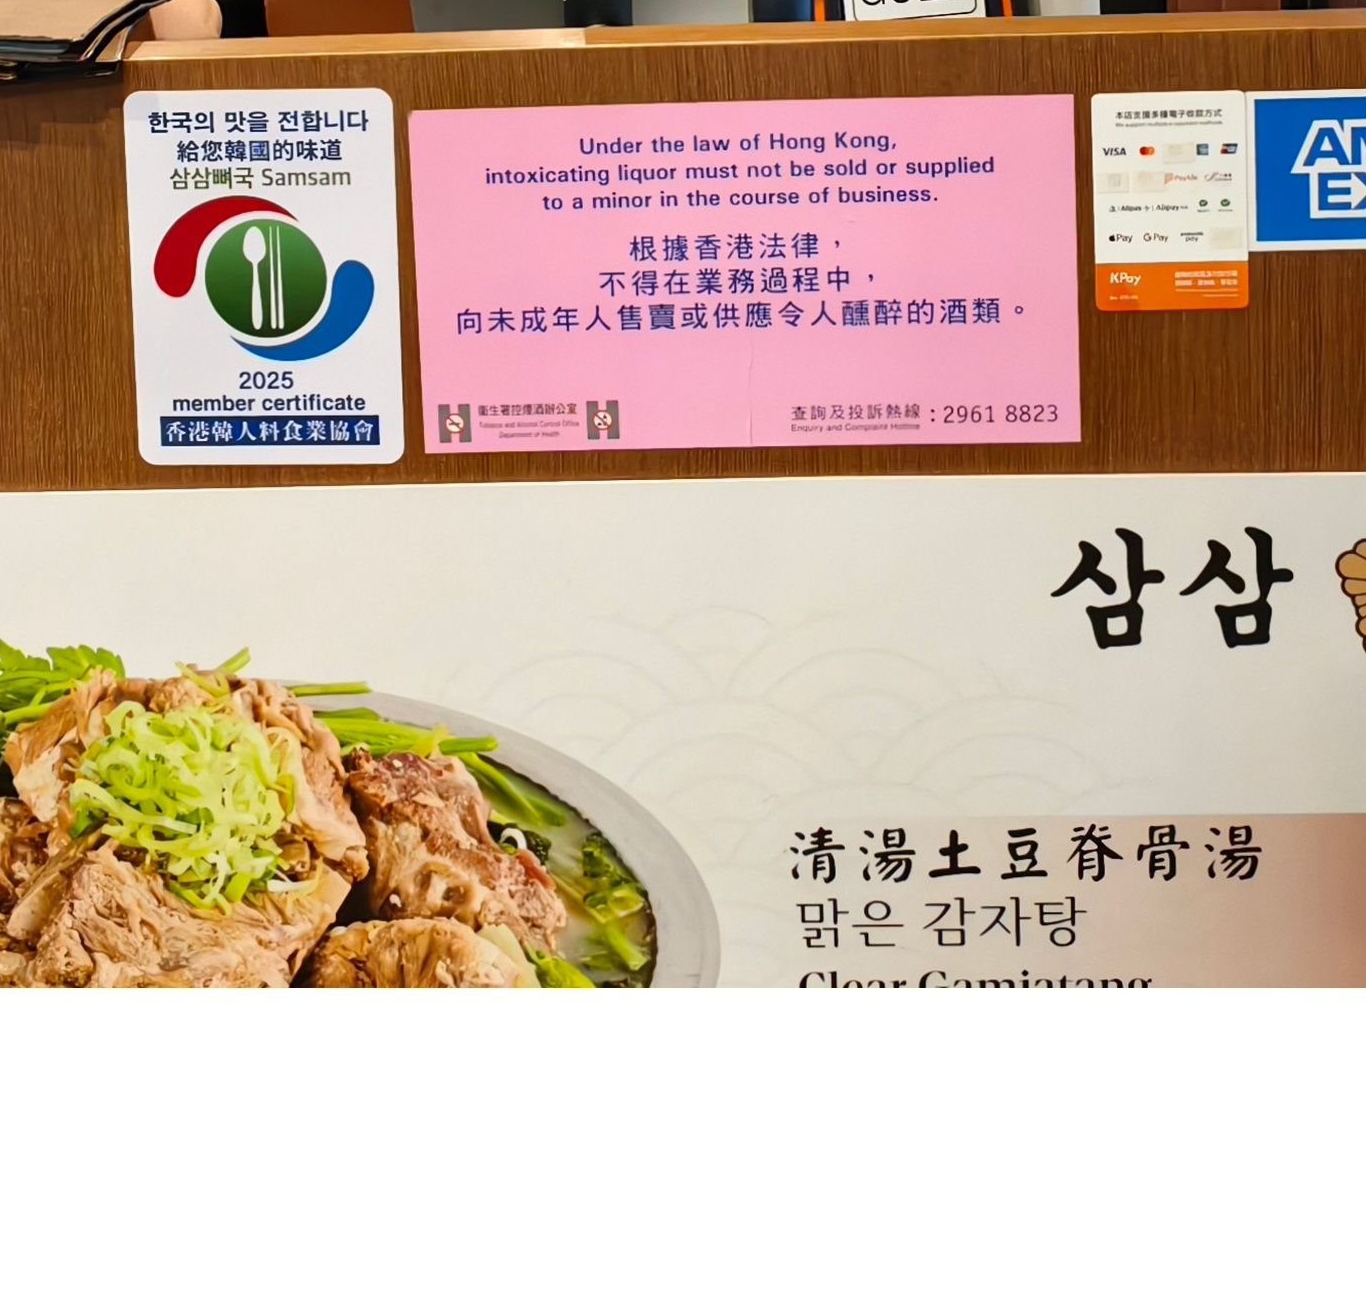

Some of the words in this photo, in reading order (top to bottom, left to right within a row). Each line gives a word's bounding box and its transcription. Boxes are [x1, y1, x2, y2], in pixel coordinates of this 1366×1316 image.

[148, 111, 215, 133] 한국의
[224, 111, 269, 132] 맛을
[278, 110, 369, 132] 전합니다
[177, 139, 343, 162] 給您韓國的味道
[580, 137, 642, 154] Under
[652, 137, 685, 153] the
[693, 135, 731, 152] law
[740, 134, 760, 151] of
[770, 133, 825, 153] Hong
[835, 132, 897, 152] Kong,
[1102, 147, 1127, 156] VISA
[170, 167, 254, 189] 삼삼뼈국
[262, 169, 352, 186] Samsam
[485, 165, 610, 186] intoxicating
[618, 164, 677, 184] liquor
[686, 164, 739, 180] must
[747, 162, 782, 178] not
[790, 160, 815, 177] be
[824, 159, 867, 176] sold
[876, 161, 897, 175] or
[906, 156, 994, 178] supplied
[542, 196, 563, 210] to
[572, 197, 584, 209] a
[592, 192, 652, 209] minor
[660, 191, 678, 207] in
[686, 190, 720, 207] the
[729, 190, 800, 206] course
[808, 187, 830, 204] of
[838, 186, 938, 204] business.
[629, 232, 842, 262] 根據香港法律，
[1116, 234, 1133, 243] Pay
[1154, 233, 1169, 243] Pay
[598, 266, 875, 298] 不得在業務過程中，
[1110, 272, 1141, 286] KPay
[456, 298, 1025, 335] 向未成年人售賣或供應令人醺醉的酒類。
[239, 372, 294, 389] 2025
[172, 395, 255, 412] member
[262, 395, 366, 412] certificate
[943, 405, 995, 424] 2961
[1005, 404, 1059, 423] 8823
[166, 419, 375, 443] 香港韓人料食業協會
[791, 424, 824, 433] Enquiry
[826, 424, 842, 432] and
[1050, 526, 1294, 649] 삼삼
[789, 824, 1263, 884] 清湯土豆脊骨湯
[796, 897, 905, 949] 맑은
[922, 895, 1087, 948] 감자탕
